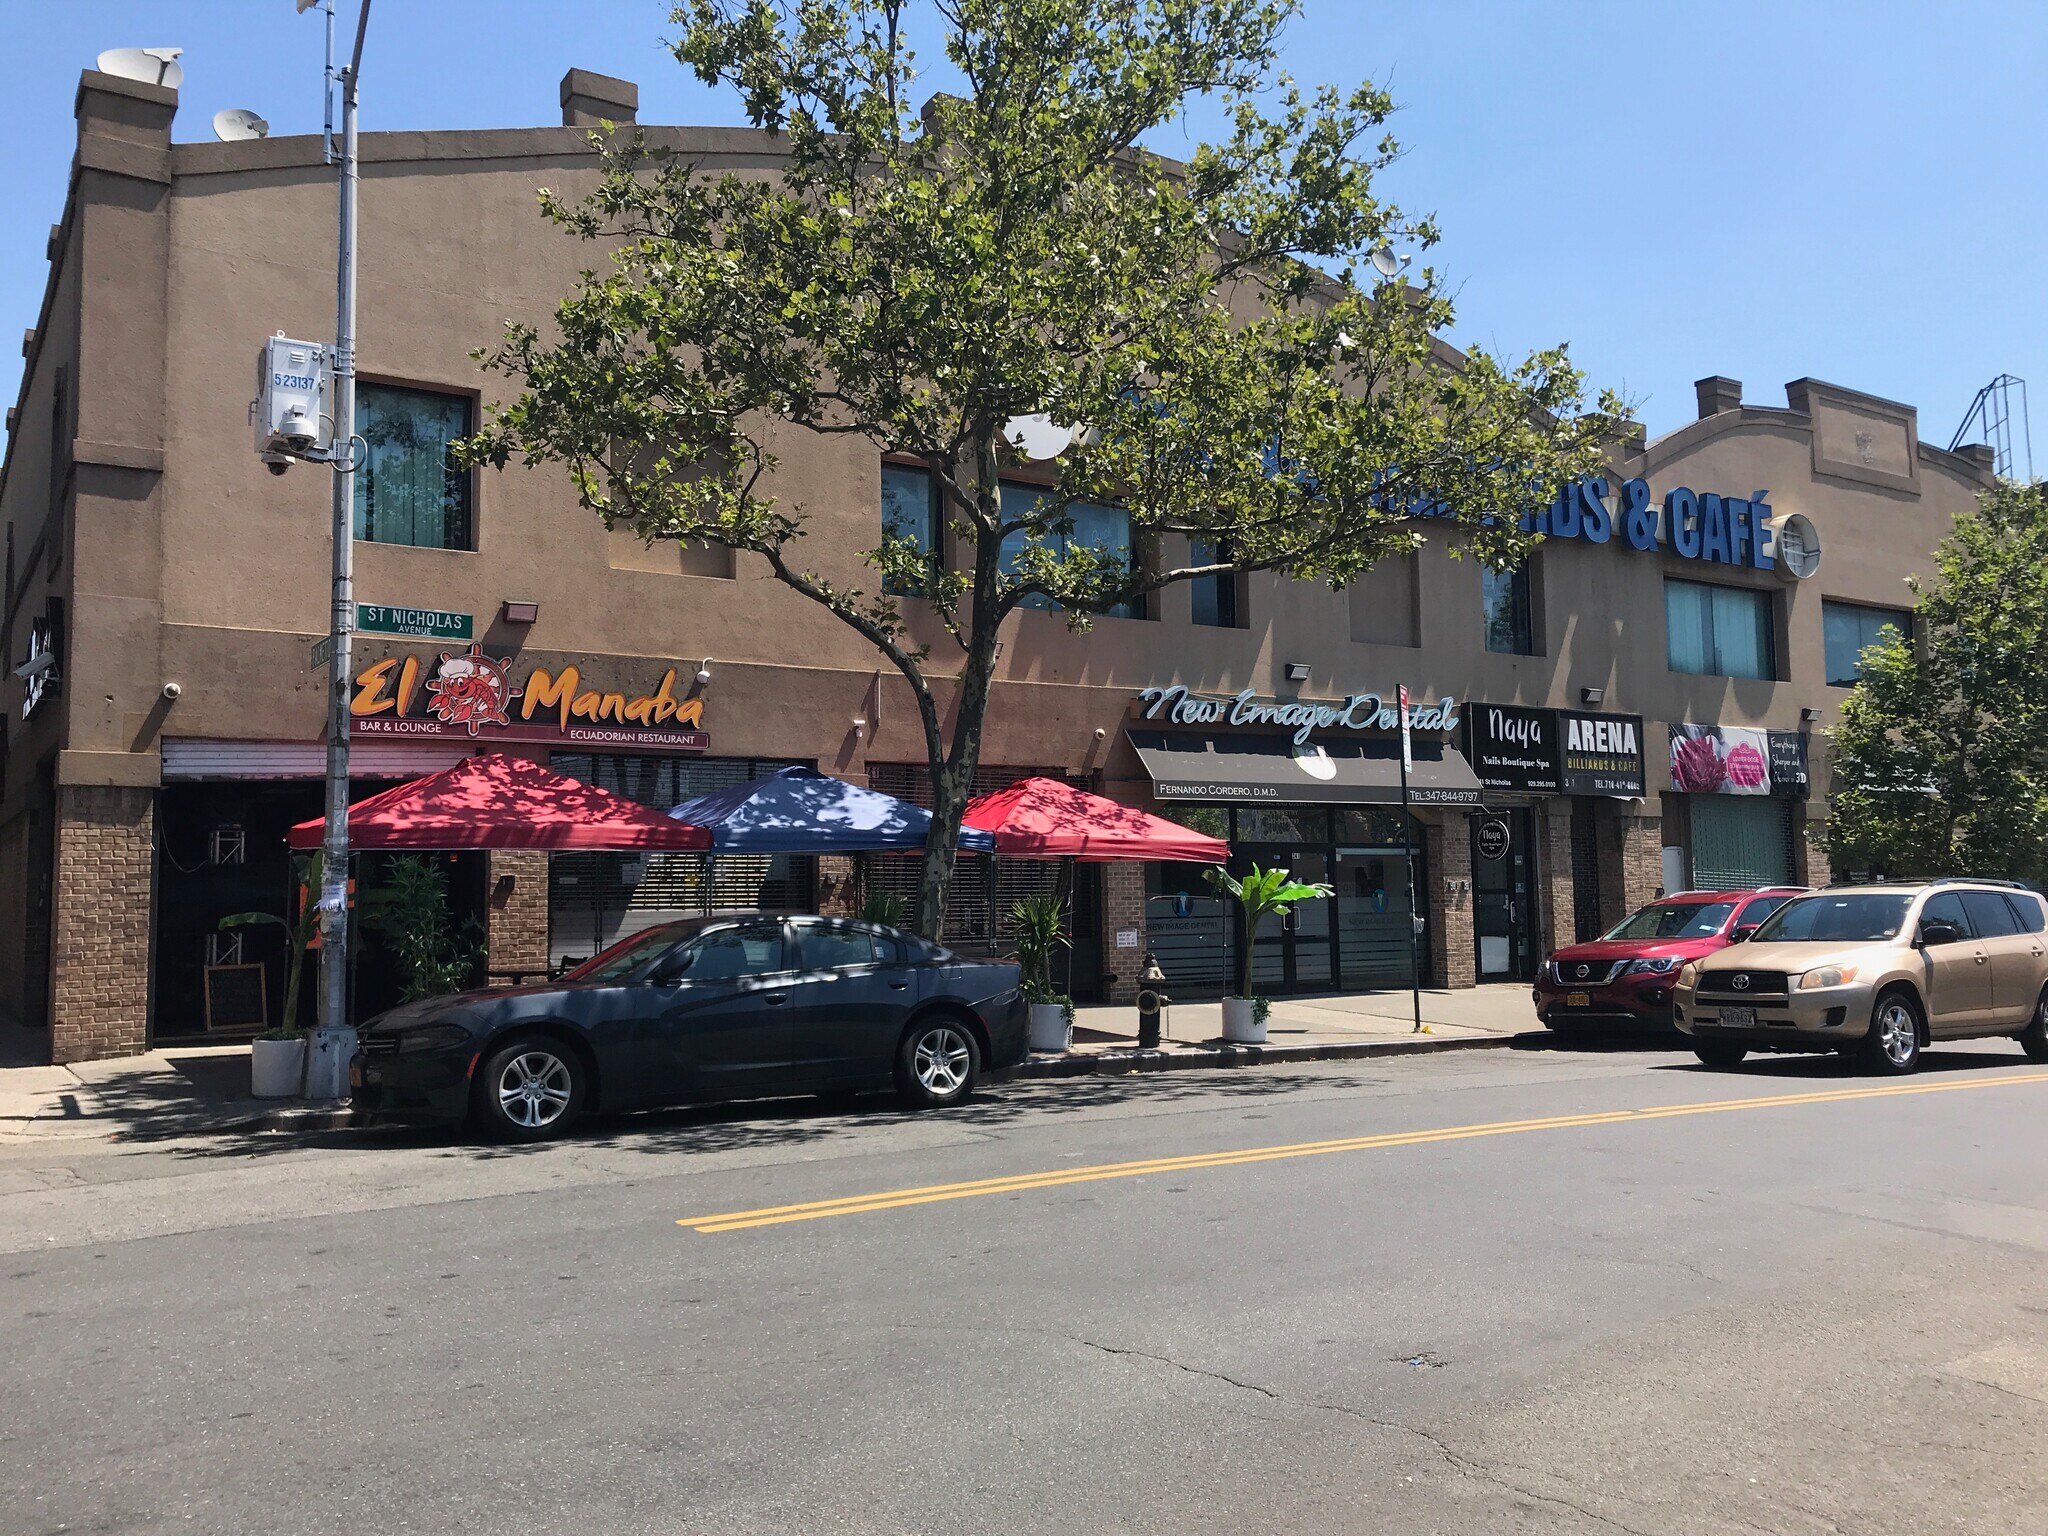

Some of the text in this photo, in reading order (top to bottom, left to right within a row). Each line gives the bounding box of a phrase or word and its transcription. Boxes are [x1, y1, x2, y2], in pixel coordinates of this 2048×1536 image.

[1620, 477, 1659, 551] &
[1665, 487, 1775, 570] CAFÉ
[368, 607, 463, 629] ST NICHOLAS
[398, 624, 432, 636] AVENUE
[521, 664, 705, 733] Manaba
[1138, 685, 1226, 725] New
[1229, 688, 1338, 746] Image
[360, 721, 442, 733] BAR & LOUNGE
[570, 729, 695, 745] ECUADORIAN RESTAURANT
[1567, 719, 1638, 755] ARENA
[1482, 755, 1550, 770] Nails Boutique Spa
[1567, 757, 1609, 771] BILLIARDS
[1795, 772, 1807, 784] 3D
[1160, 784, 1207, 795] FERNANDO
[1253, 787, 1279, 797] D.M.D.
